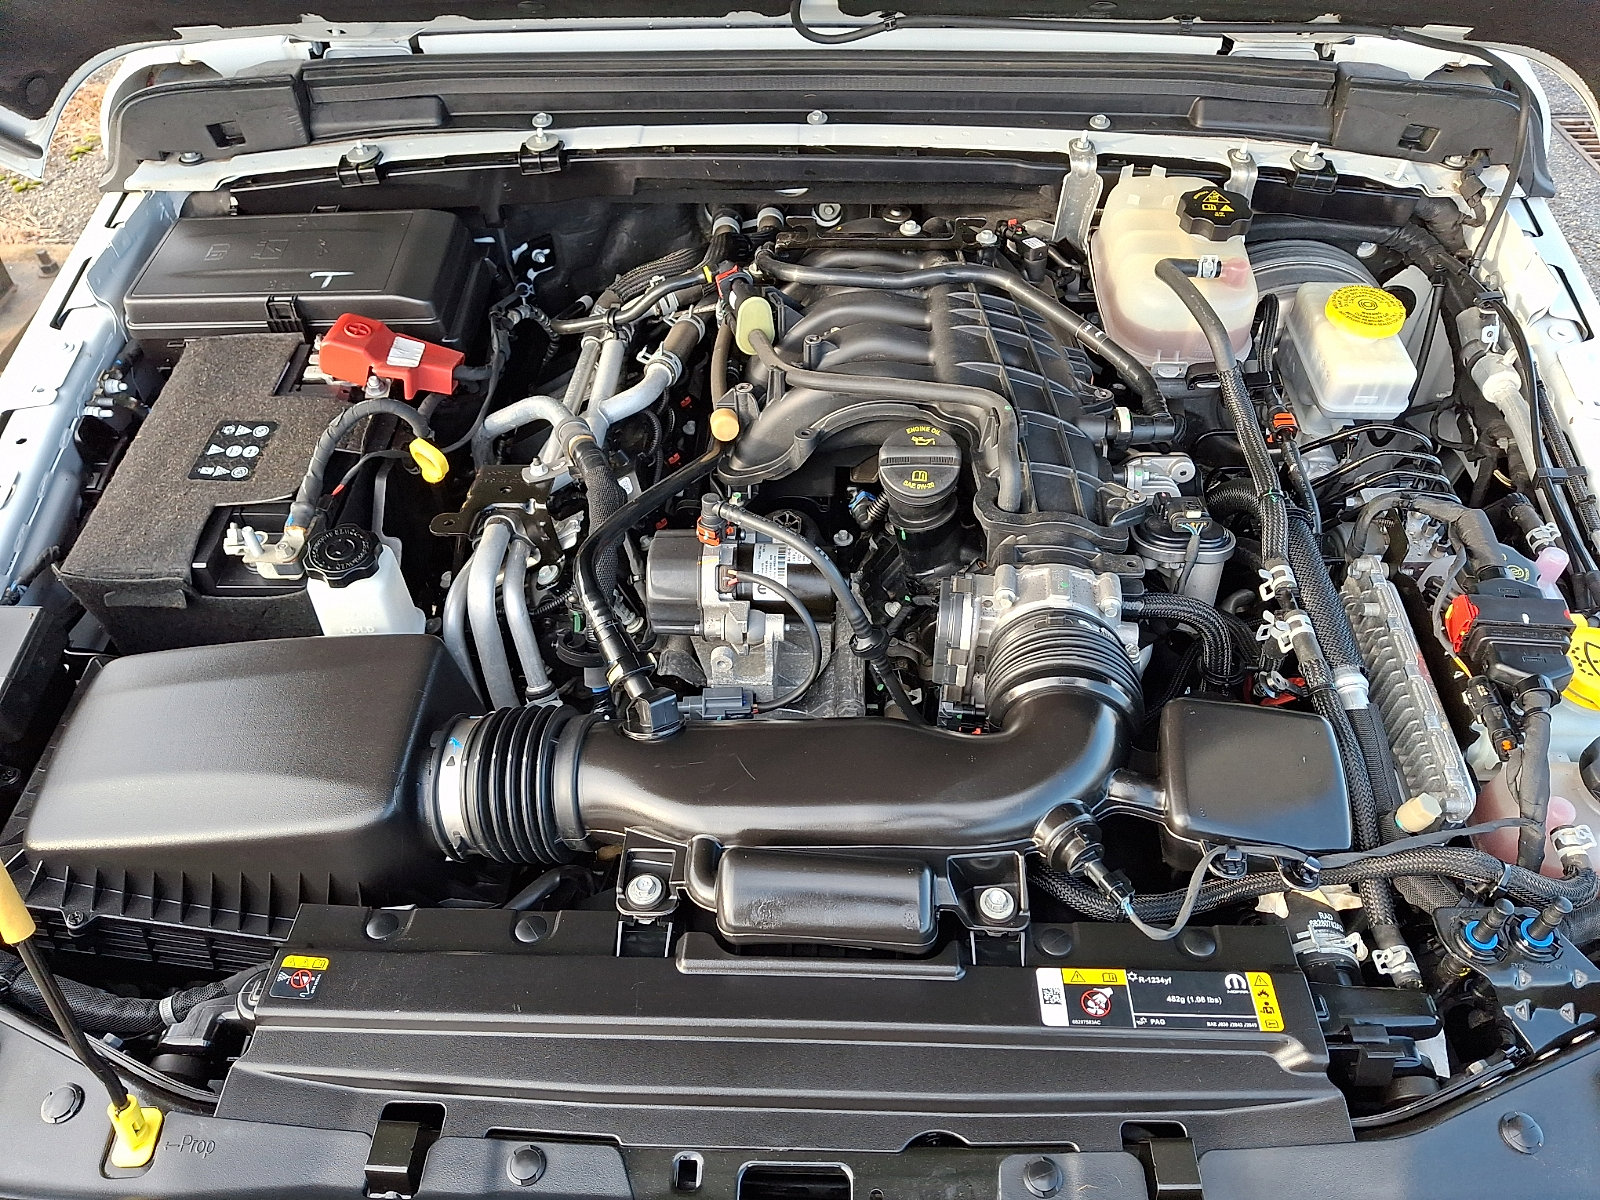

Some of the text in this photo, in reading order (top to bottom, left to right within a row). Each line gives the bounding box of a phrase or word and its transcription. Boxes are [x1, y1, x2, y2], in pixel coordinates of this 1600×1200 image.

[905, 425, 941, 436] ENGINE OIL
[1317, 911, 1334, 921] RAD
[1138, 976, 1172, 985] R-1234yf
[1166, 995, 1186, 1004] 482g
[179, 1134, 216, 1159] Prop
